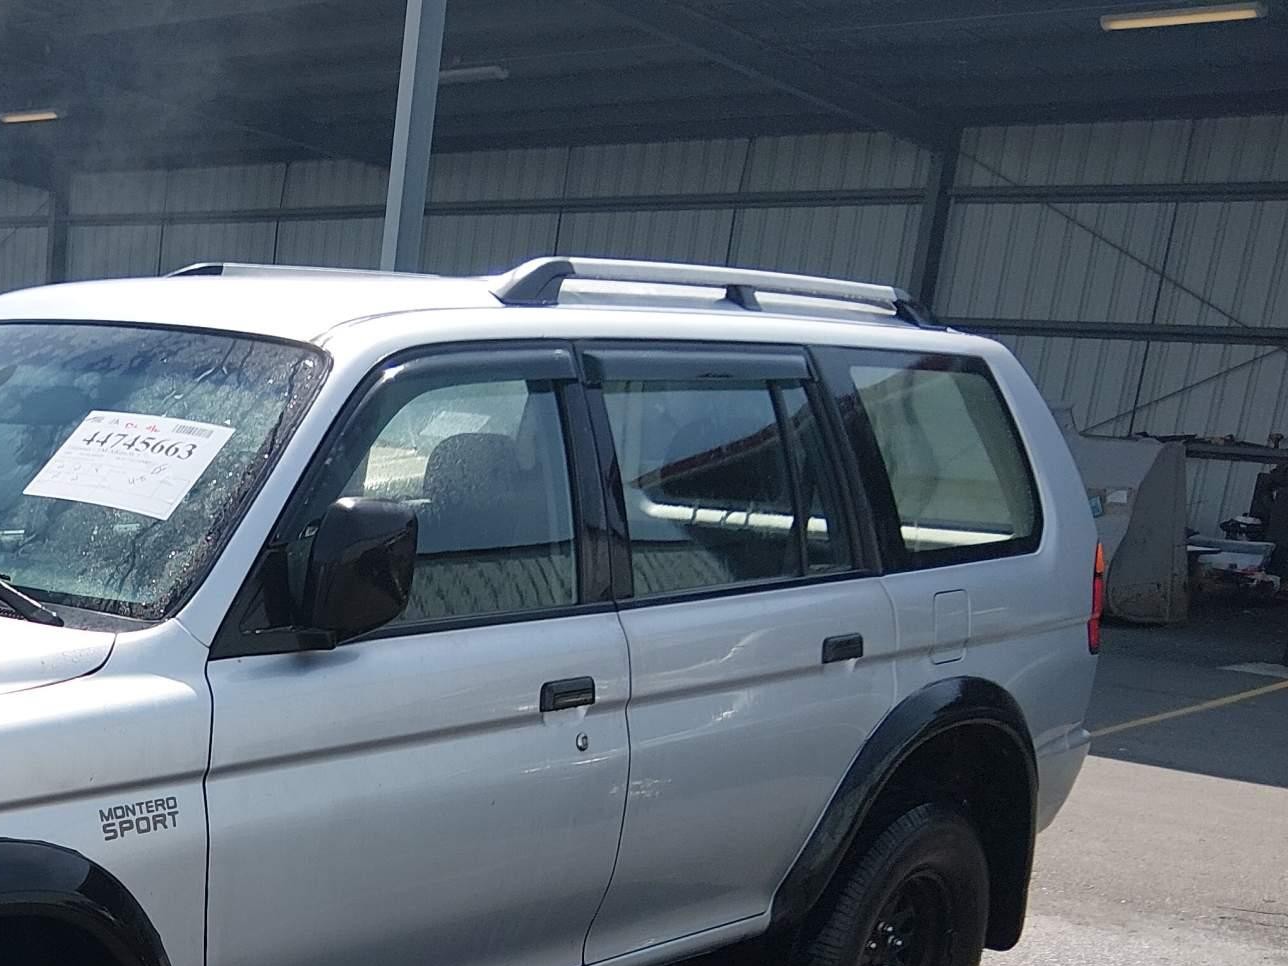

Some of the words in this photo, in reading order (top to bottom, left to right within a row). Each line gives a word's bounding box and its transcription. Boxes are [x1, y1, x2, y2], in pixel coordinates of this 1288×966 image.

[82, 431, 198, 460] 44745663
[98, 796, 178, 822] MONTERO
[102, 811, 179, 841] SPORT
